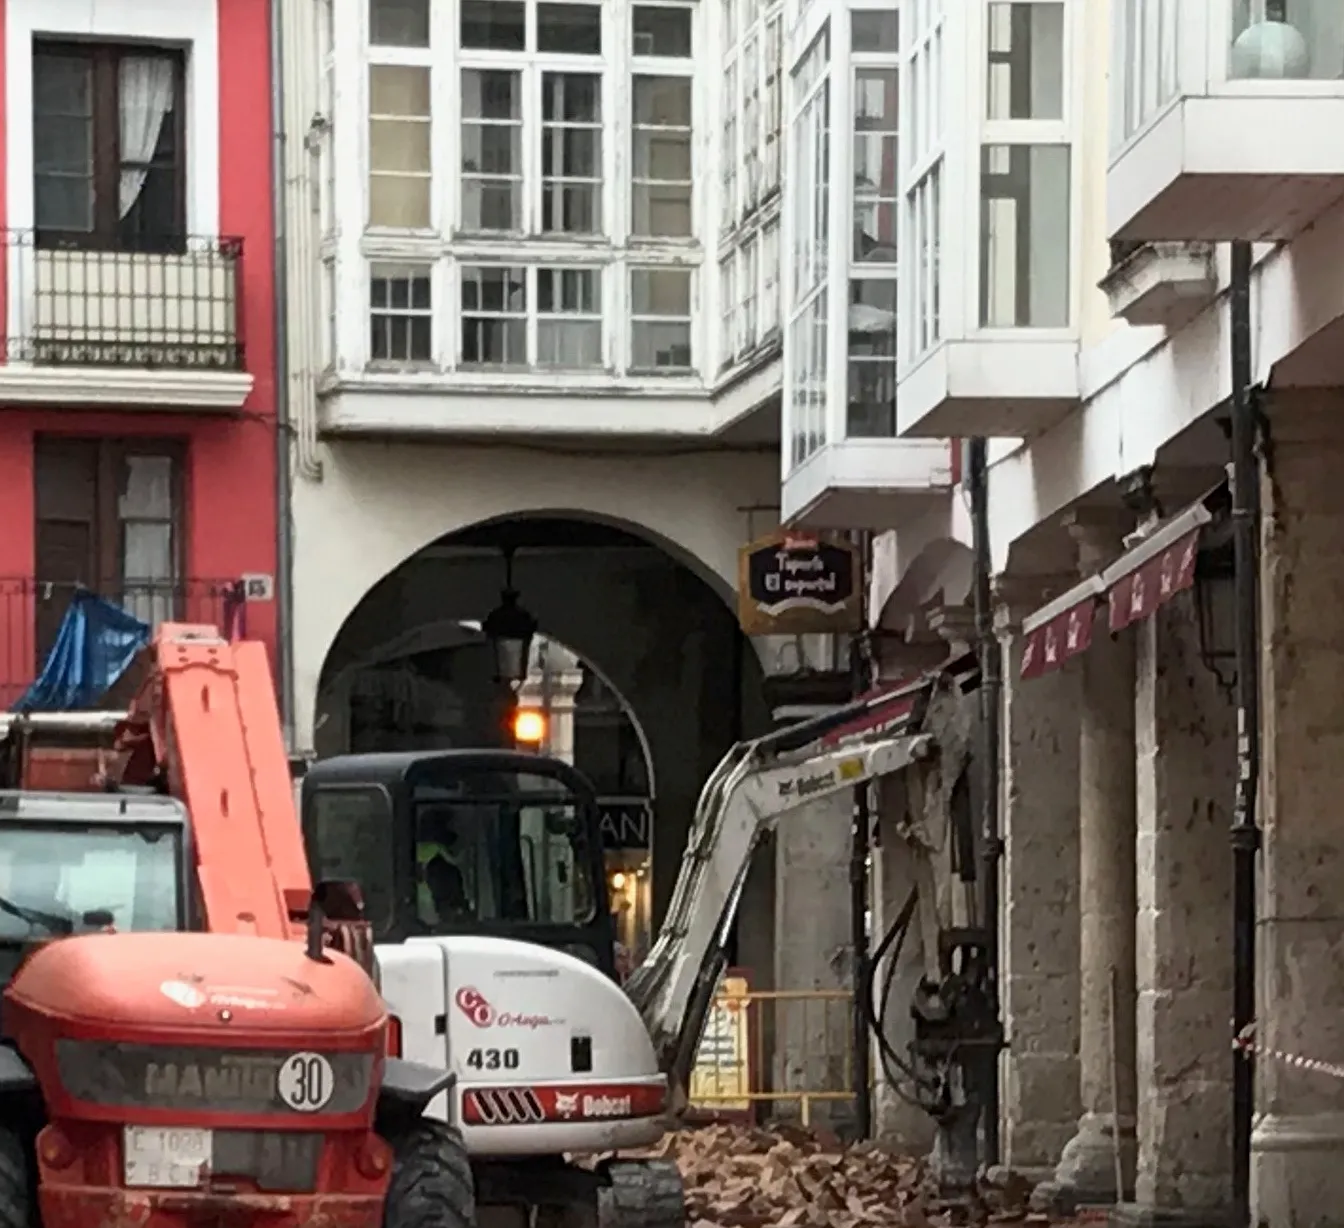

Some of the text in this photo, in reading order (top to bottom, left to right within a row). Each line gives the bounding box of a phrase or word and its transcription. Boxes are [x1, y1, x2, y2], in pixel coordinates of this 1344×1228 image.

[467, 1048, 520, 1070] 430
[290, 1056, 323, 1105] 30
[582, 1094, 632, 1117] Bobcat
